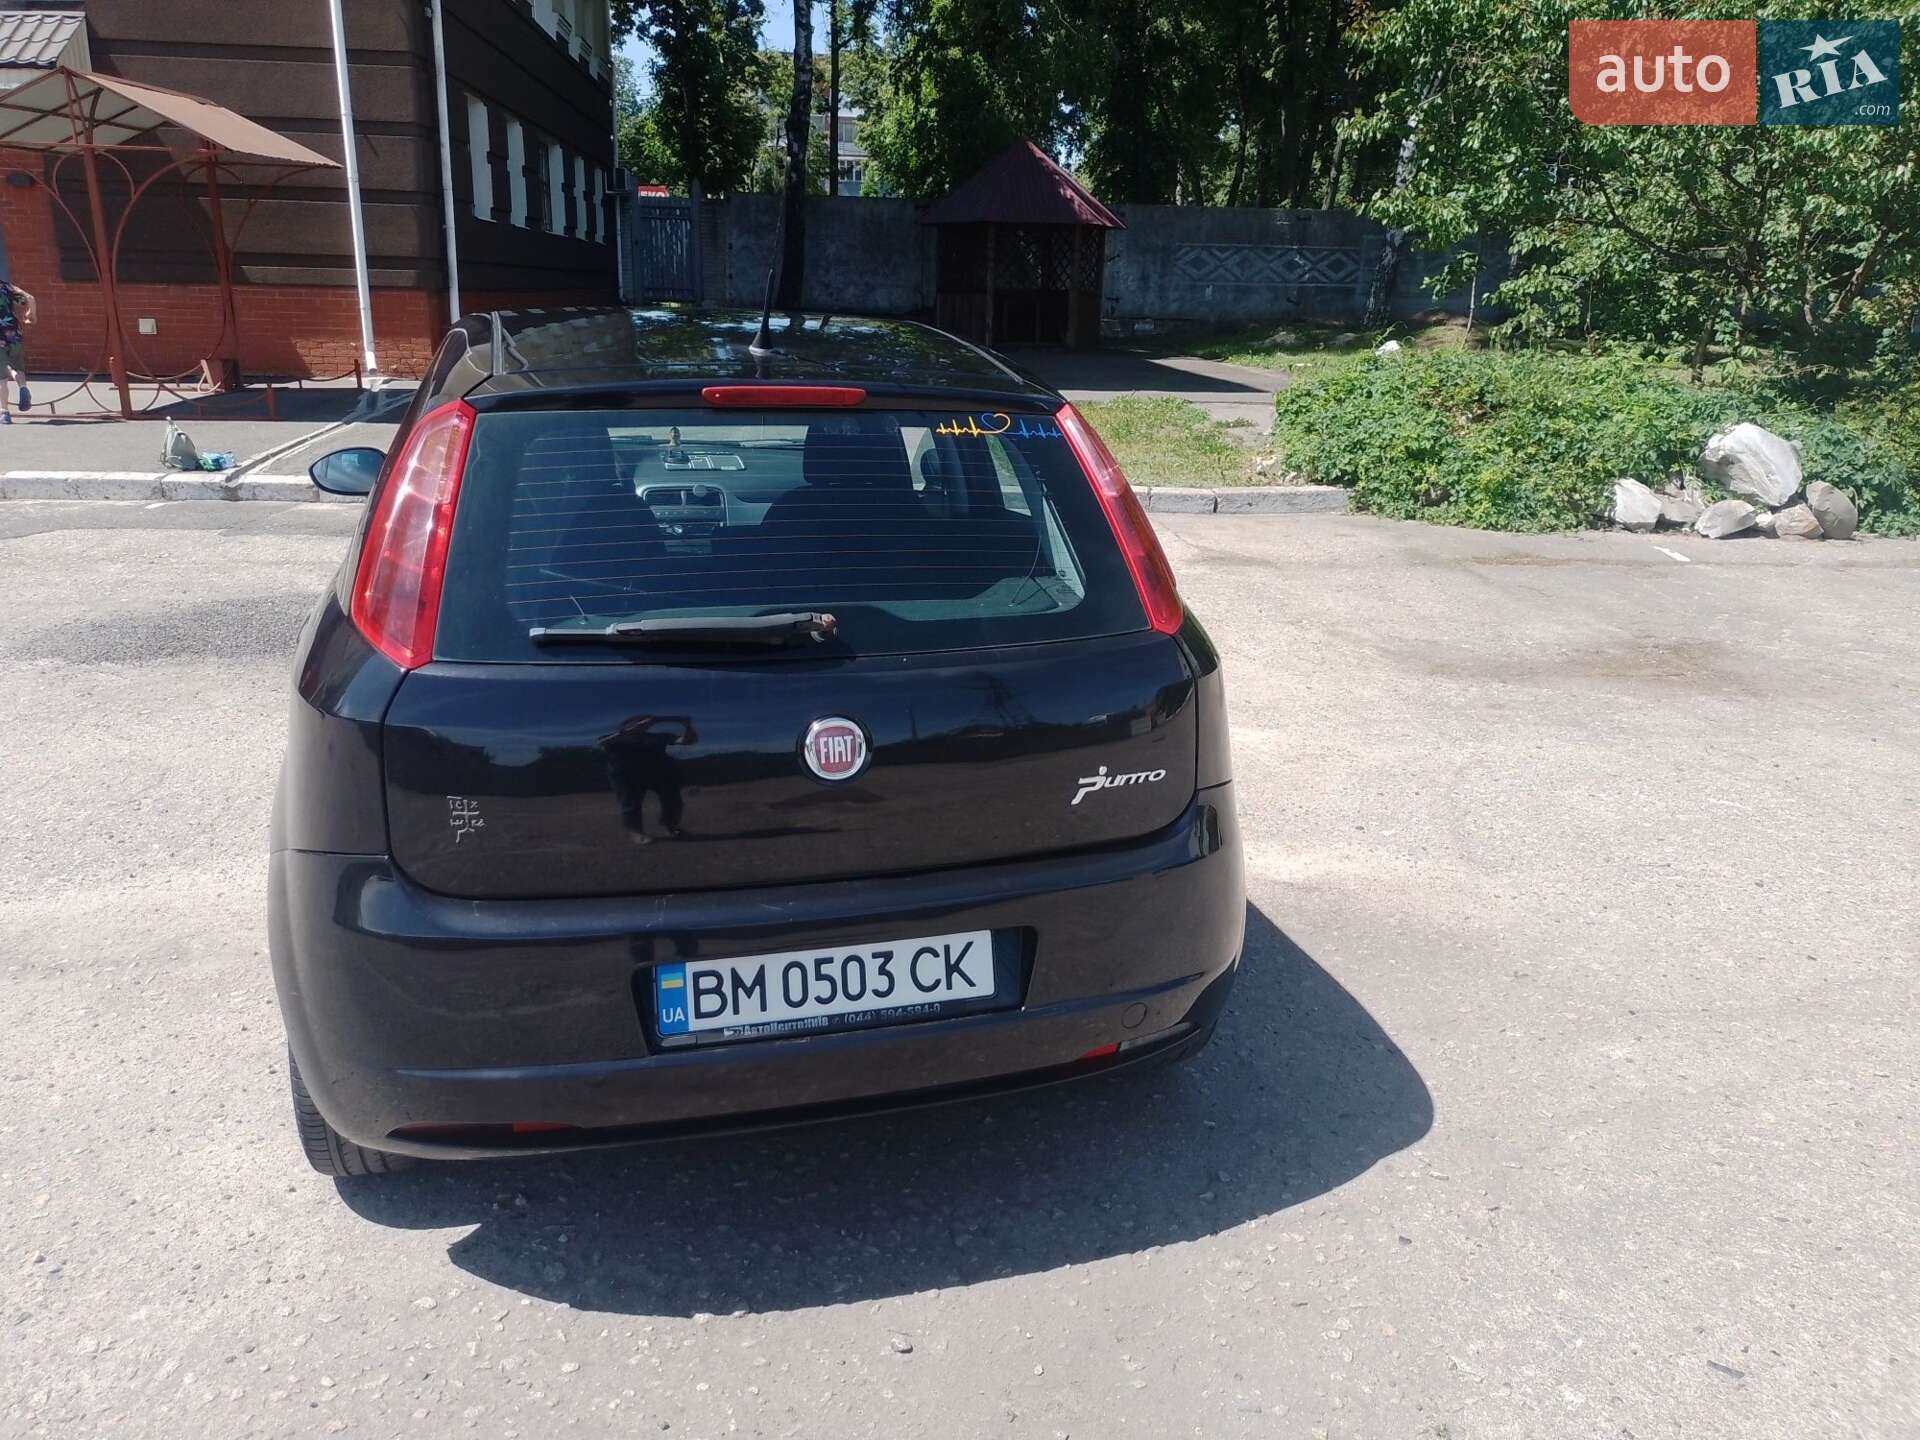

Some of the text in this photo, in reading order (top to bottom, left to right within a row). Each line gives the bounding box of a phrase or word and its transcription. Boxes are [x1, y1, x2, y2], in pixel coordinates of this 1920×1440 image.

[820, 736, 853, 764] FIAT
[1071, 766, 1166, 806] Punto
[692, 940, 977, 1020] BM 0503 CK
[662, 1008, 685, 1023] UA
